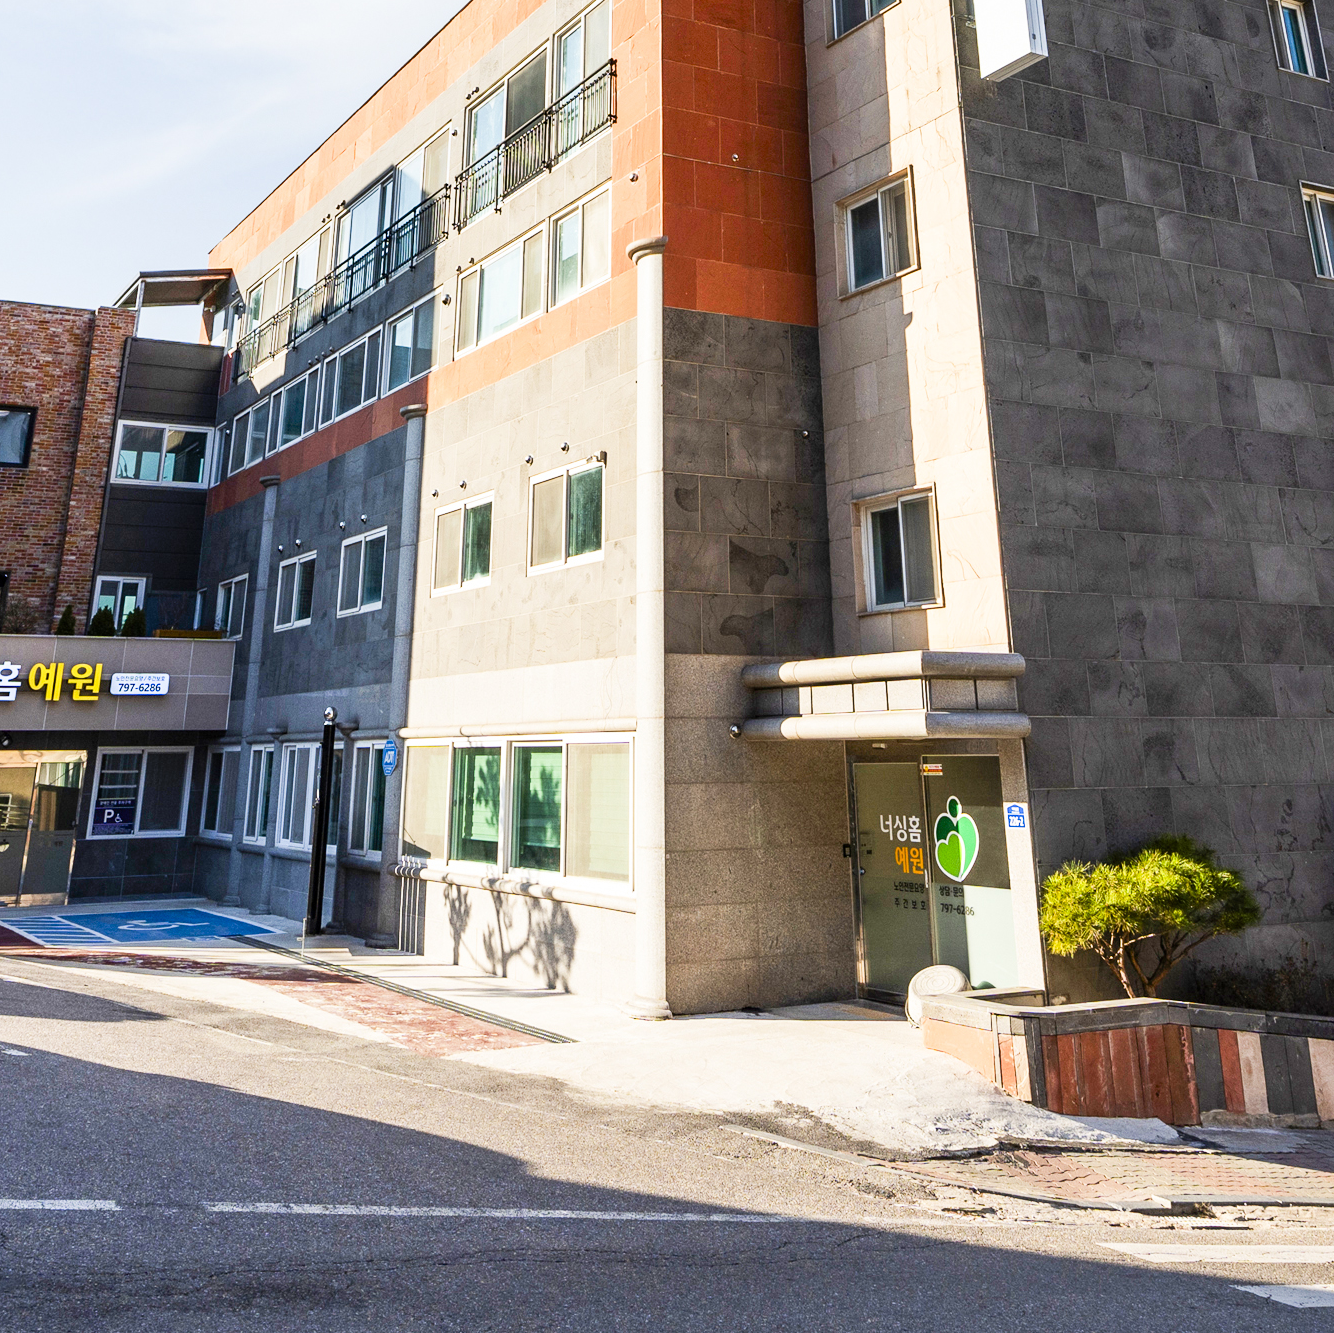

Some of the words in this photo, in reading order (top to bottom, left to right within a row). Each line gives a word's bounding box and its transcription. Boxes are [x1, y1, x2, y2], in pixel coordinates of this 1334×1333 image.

[28, 662, 102, 701] 예원
[118, 683, 161, 692] 797-6286
[103, 809, 115, 823] P
[879, 814, 922, 843] 너싱홈
[894, 846, 924, 875] 예원
[940, 903, 975, 916] 797-6286
